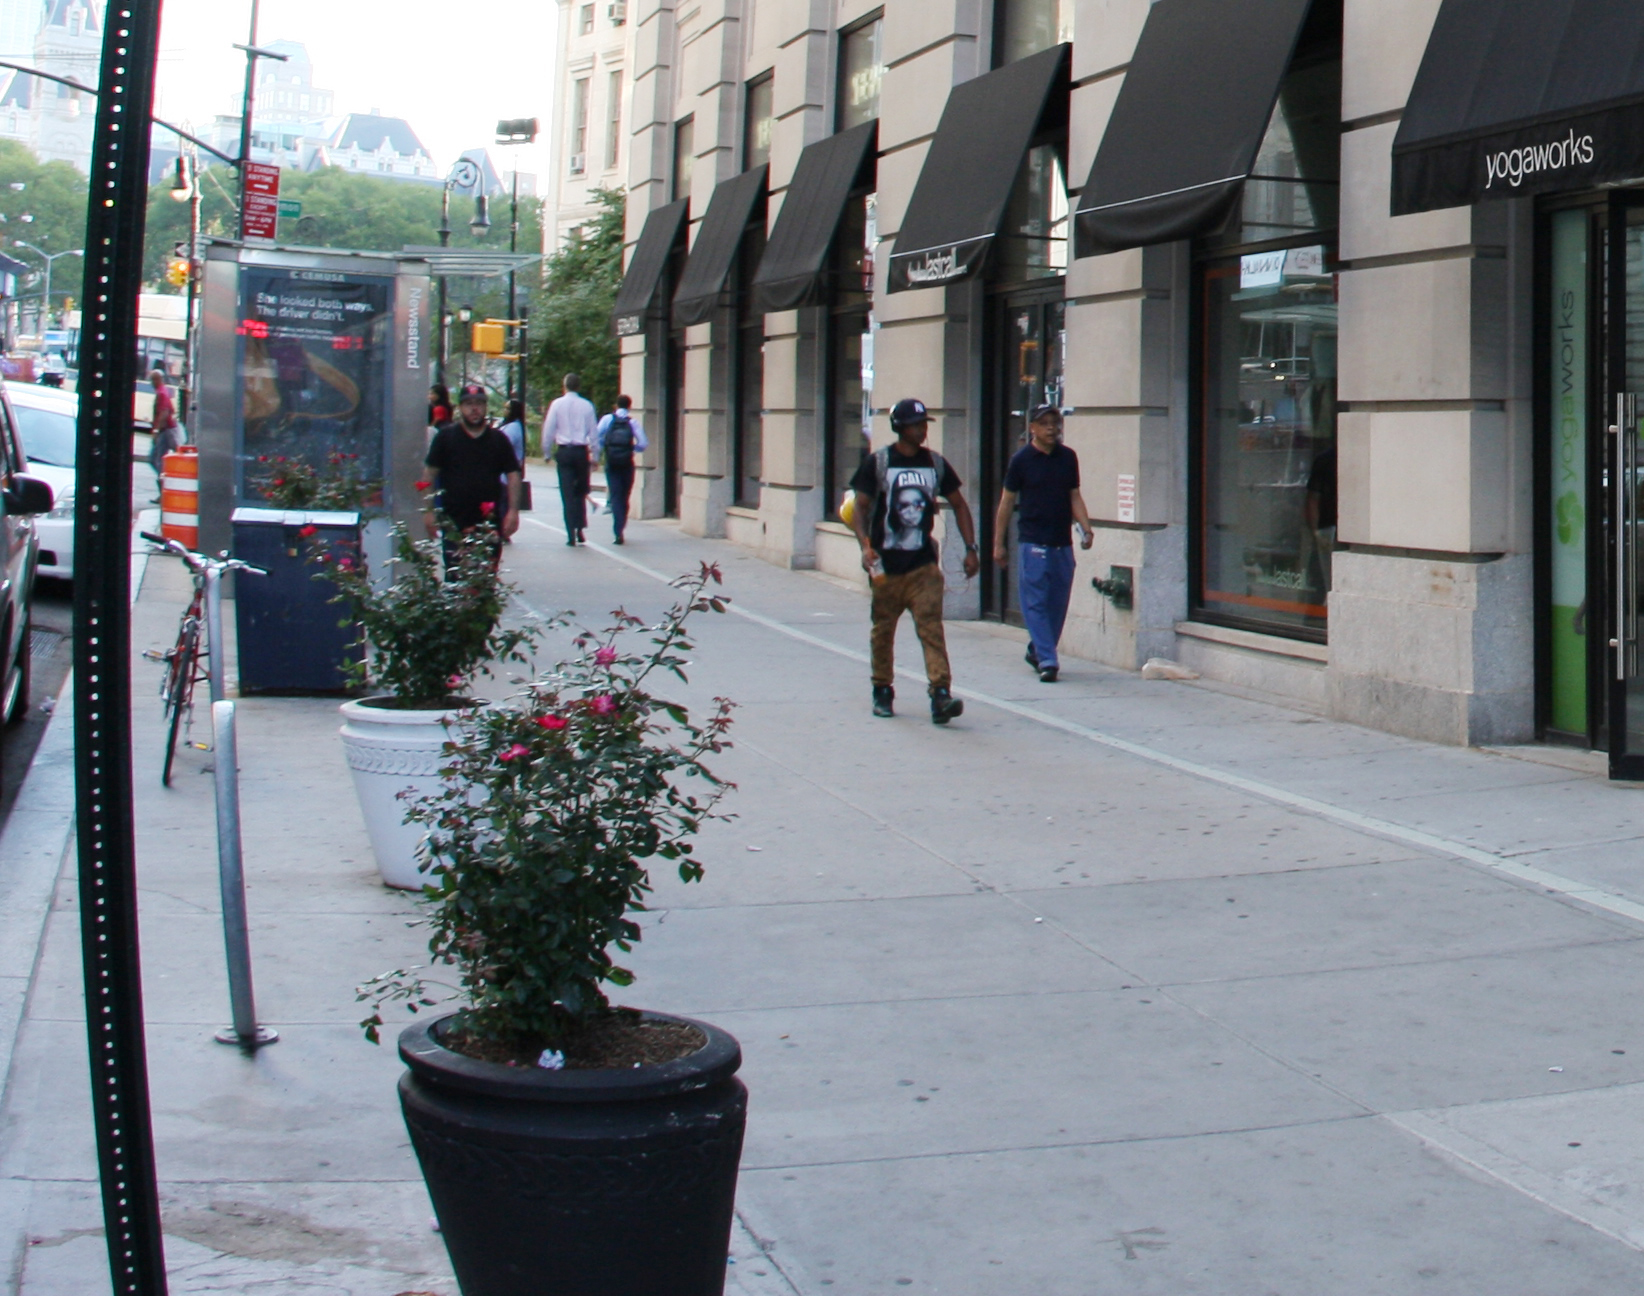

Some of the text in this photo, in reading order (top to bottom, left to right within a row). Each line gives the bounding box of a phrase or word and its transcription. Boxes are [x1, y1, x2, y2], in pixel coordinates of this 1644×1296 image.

[1485, 128, 1594, 189] yogaworks
[301, 271, 345, 282] CEMUSA
[256, 305, 278, 317] The
[279, 307, 310, 320] driver
[279, 294, 316, 308] looked
[317, 297, 343, 310] both
[406, 287, 422, 369] Newsstand
[1557, 290, 1578, 482] yogaworks
